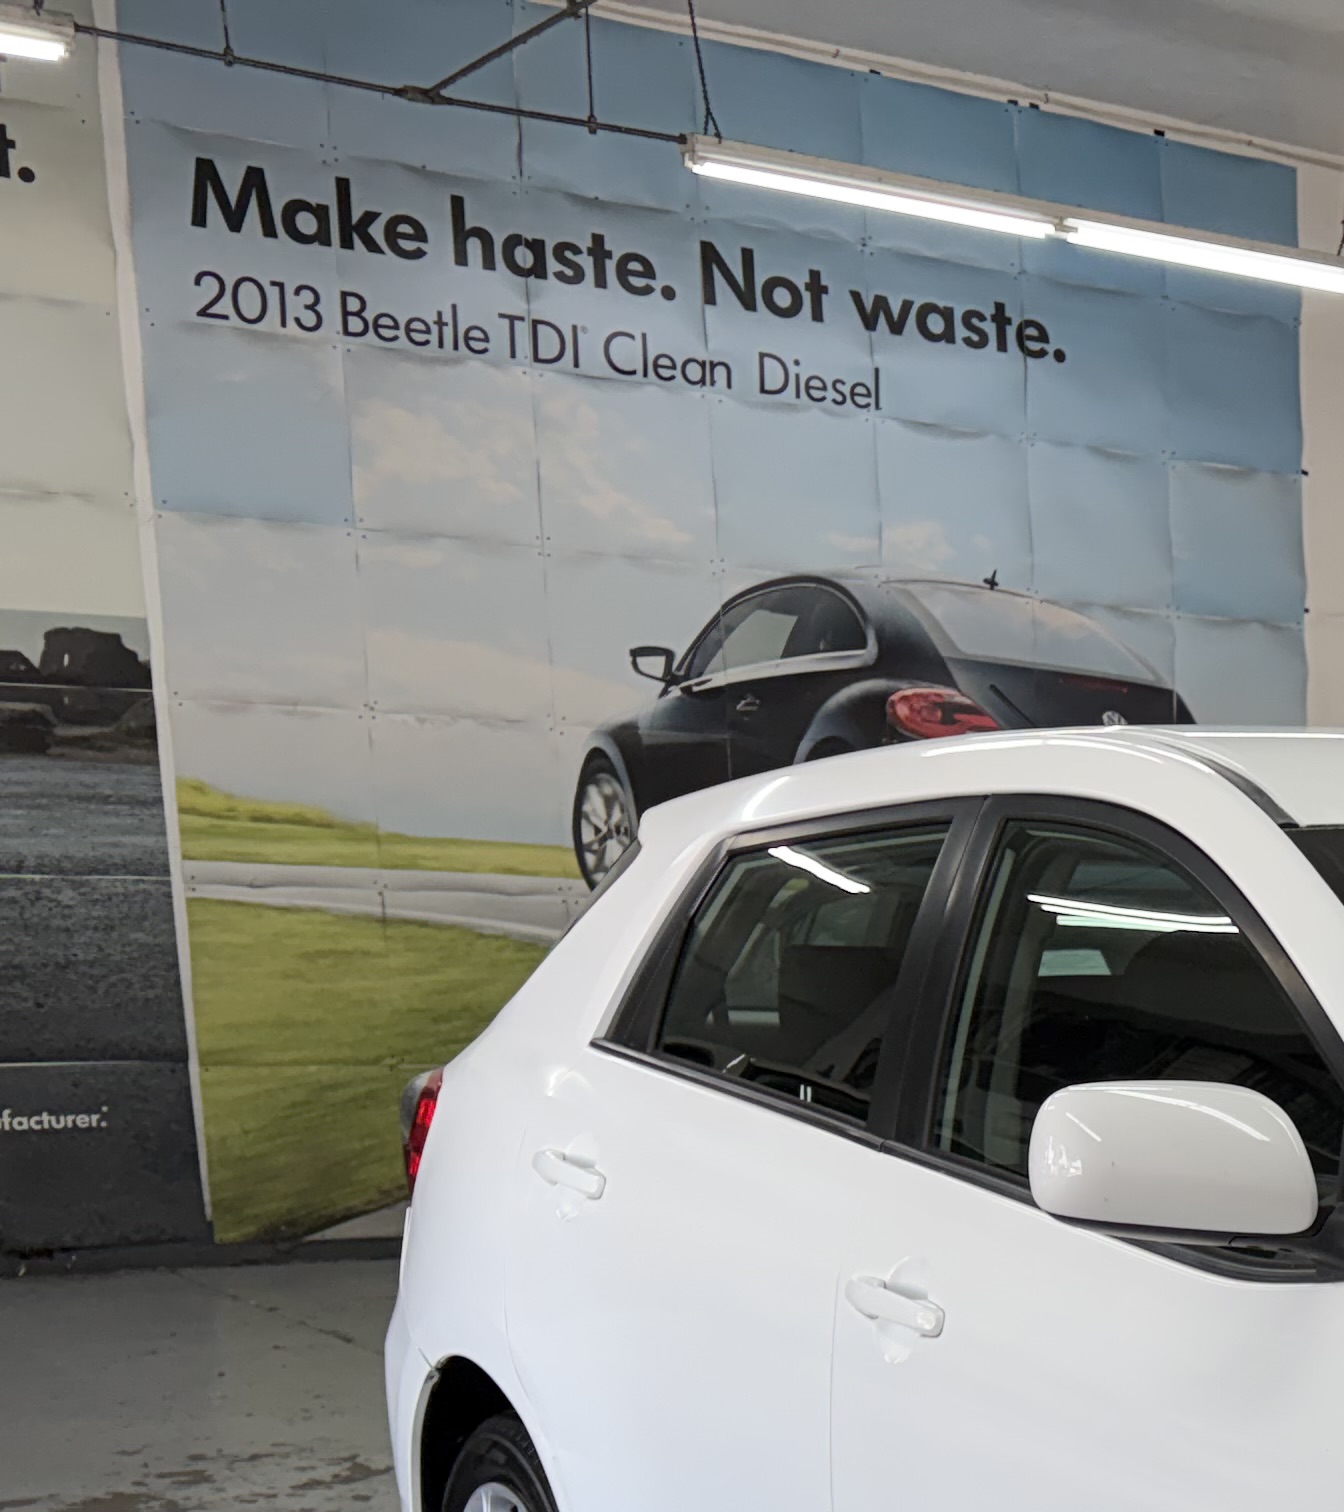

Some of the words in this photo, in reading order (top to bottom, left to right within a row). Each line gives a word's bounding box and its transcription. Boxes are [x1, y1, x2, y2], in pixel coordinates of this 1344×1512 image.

[191, 156, 429, 260] Make
[450, 193, 677, 302] haste.
[699, 239, 829, 323] Not
[848, 288, 1067, 364] waste.
[193, 269, 324, 333] 2013
[339, 289, 491, 355] Beetle
[602, 330, 732, 390] Clean
[757, 350, 882, 411] Diesel
[0, 1107, 108, 1131] facturer.
